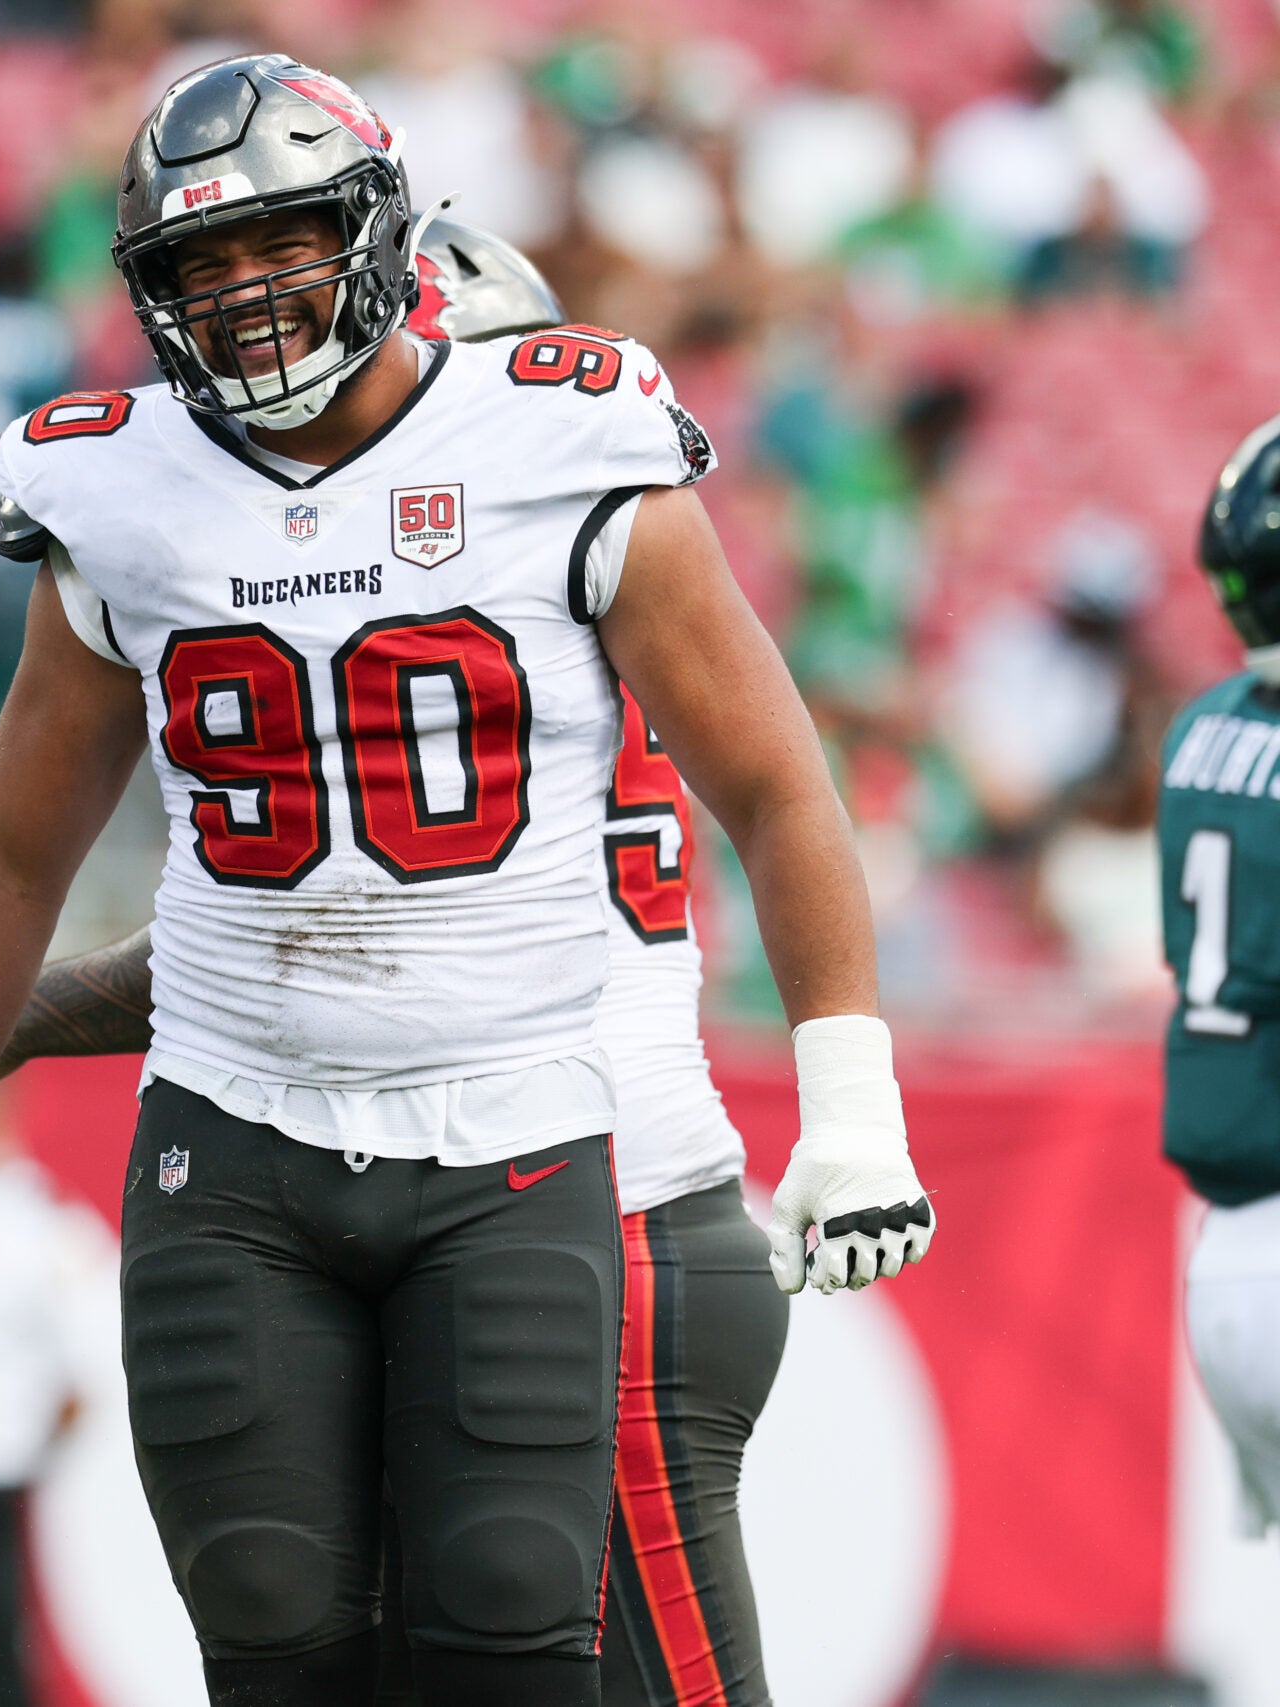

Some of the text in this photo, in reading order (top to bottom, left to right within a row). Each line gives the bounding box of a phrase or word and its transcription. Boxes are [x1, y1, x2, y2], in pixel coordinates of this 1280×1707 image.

[183, 180, 222, 208] BUCS
[288, 519, 314, 536] NFL
[399, 493, 454, 532] 50
[409, 532, 447, 541] SEASONS
[229, 564, 382, 608] BUCCANEERS
[157, 604, 532, 890] 90
[1163, 713, 1280, 800] HURT
[1181, 830, 1251, 1037] 1
[163, 1167, 182, 1186] NFL
